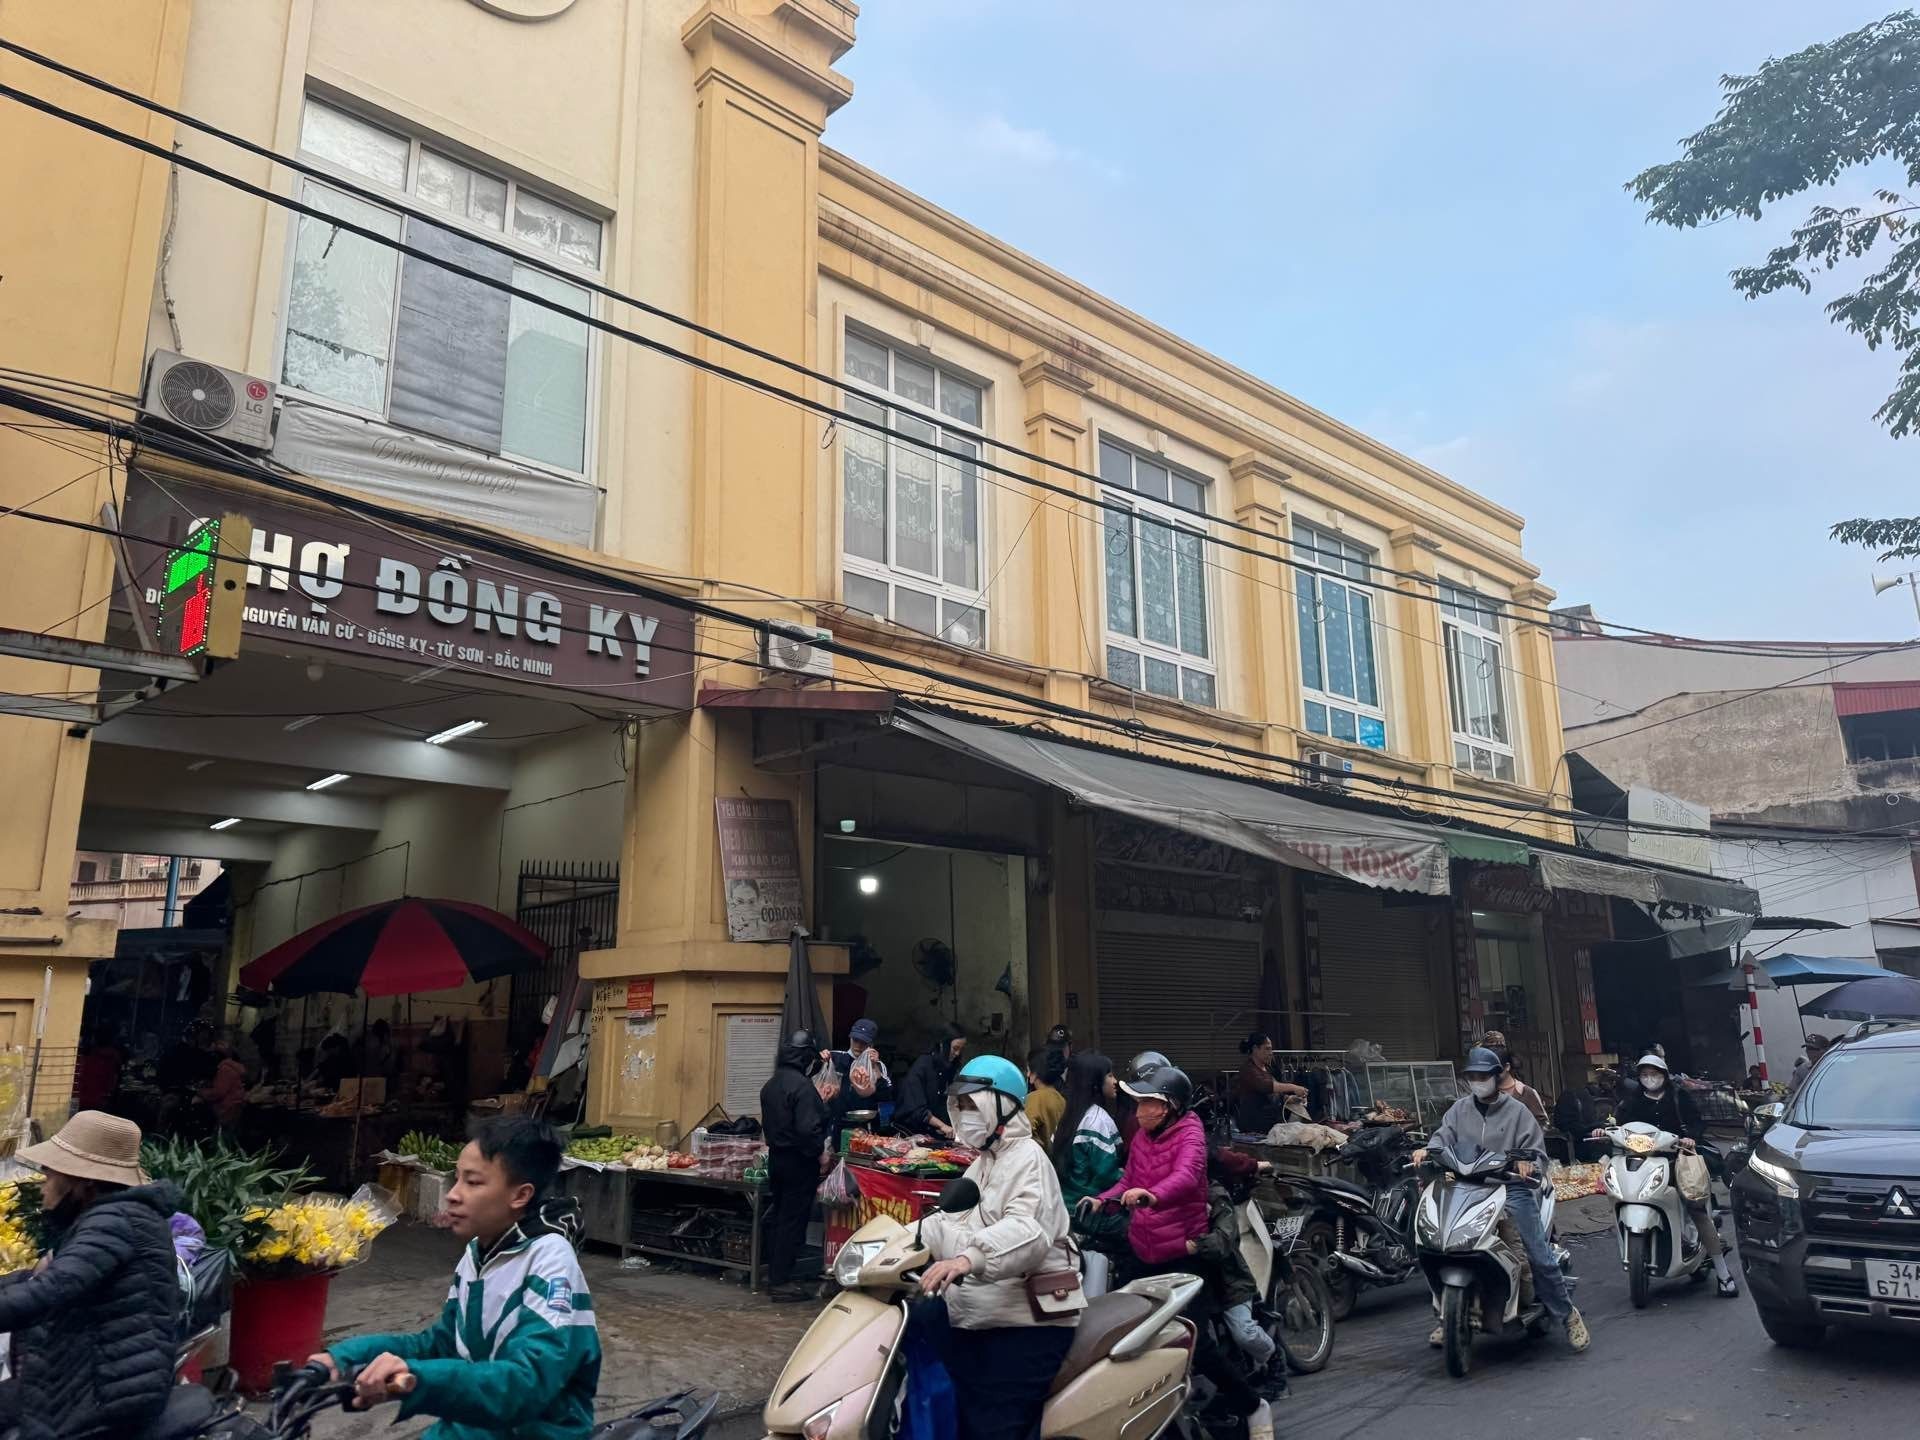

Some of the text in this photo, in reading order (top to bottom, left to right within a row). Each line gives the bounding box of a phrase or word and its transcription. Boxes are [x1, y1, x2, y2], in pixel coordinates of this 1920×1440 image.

[246, 400, 263, 414] LG
[188, 517, 659, 675] HỢ ĐỒNG KỴ
[302, 616, 330, 636] VĂN
[335, 622, 357, 640] CỪ
[409, 637, 428, 656] KỴ
[437, 640, 455, 658] TỪ
[457, 645, 484, 664] SƠN
[495, 650, 519, 669] BẮC
[522, 658, 552, 676] NINH
